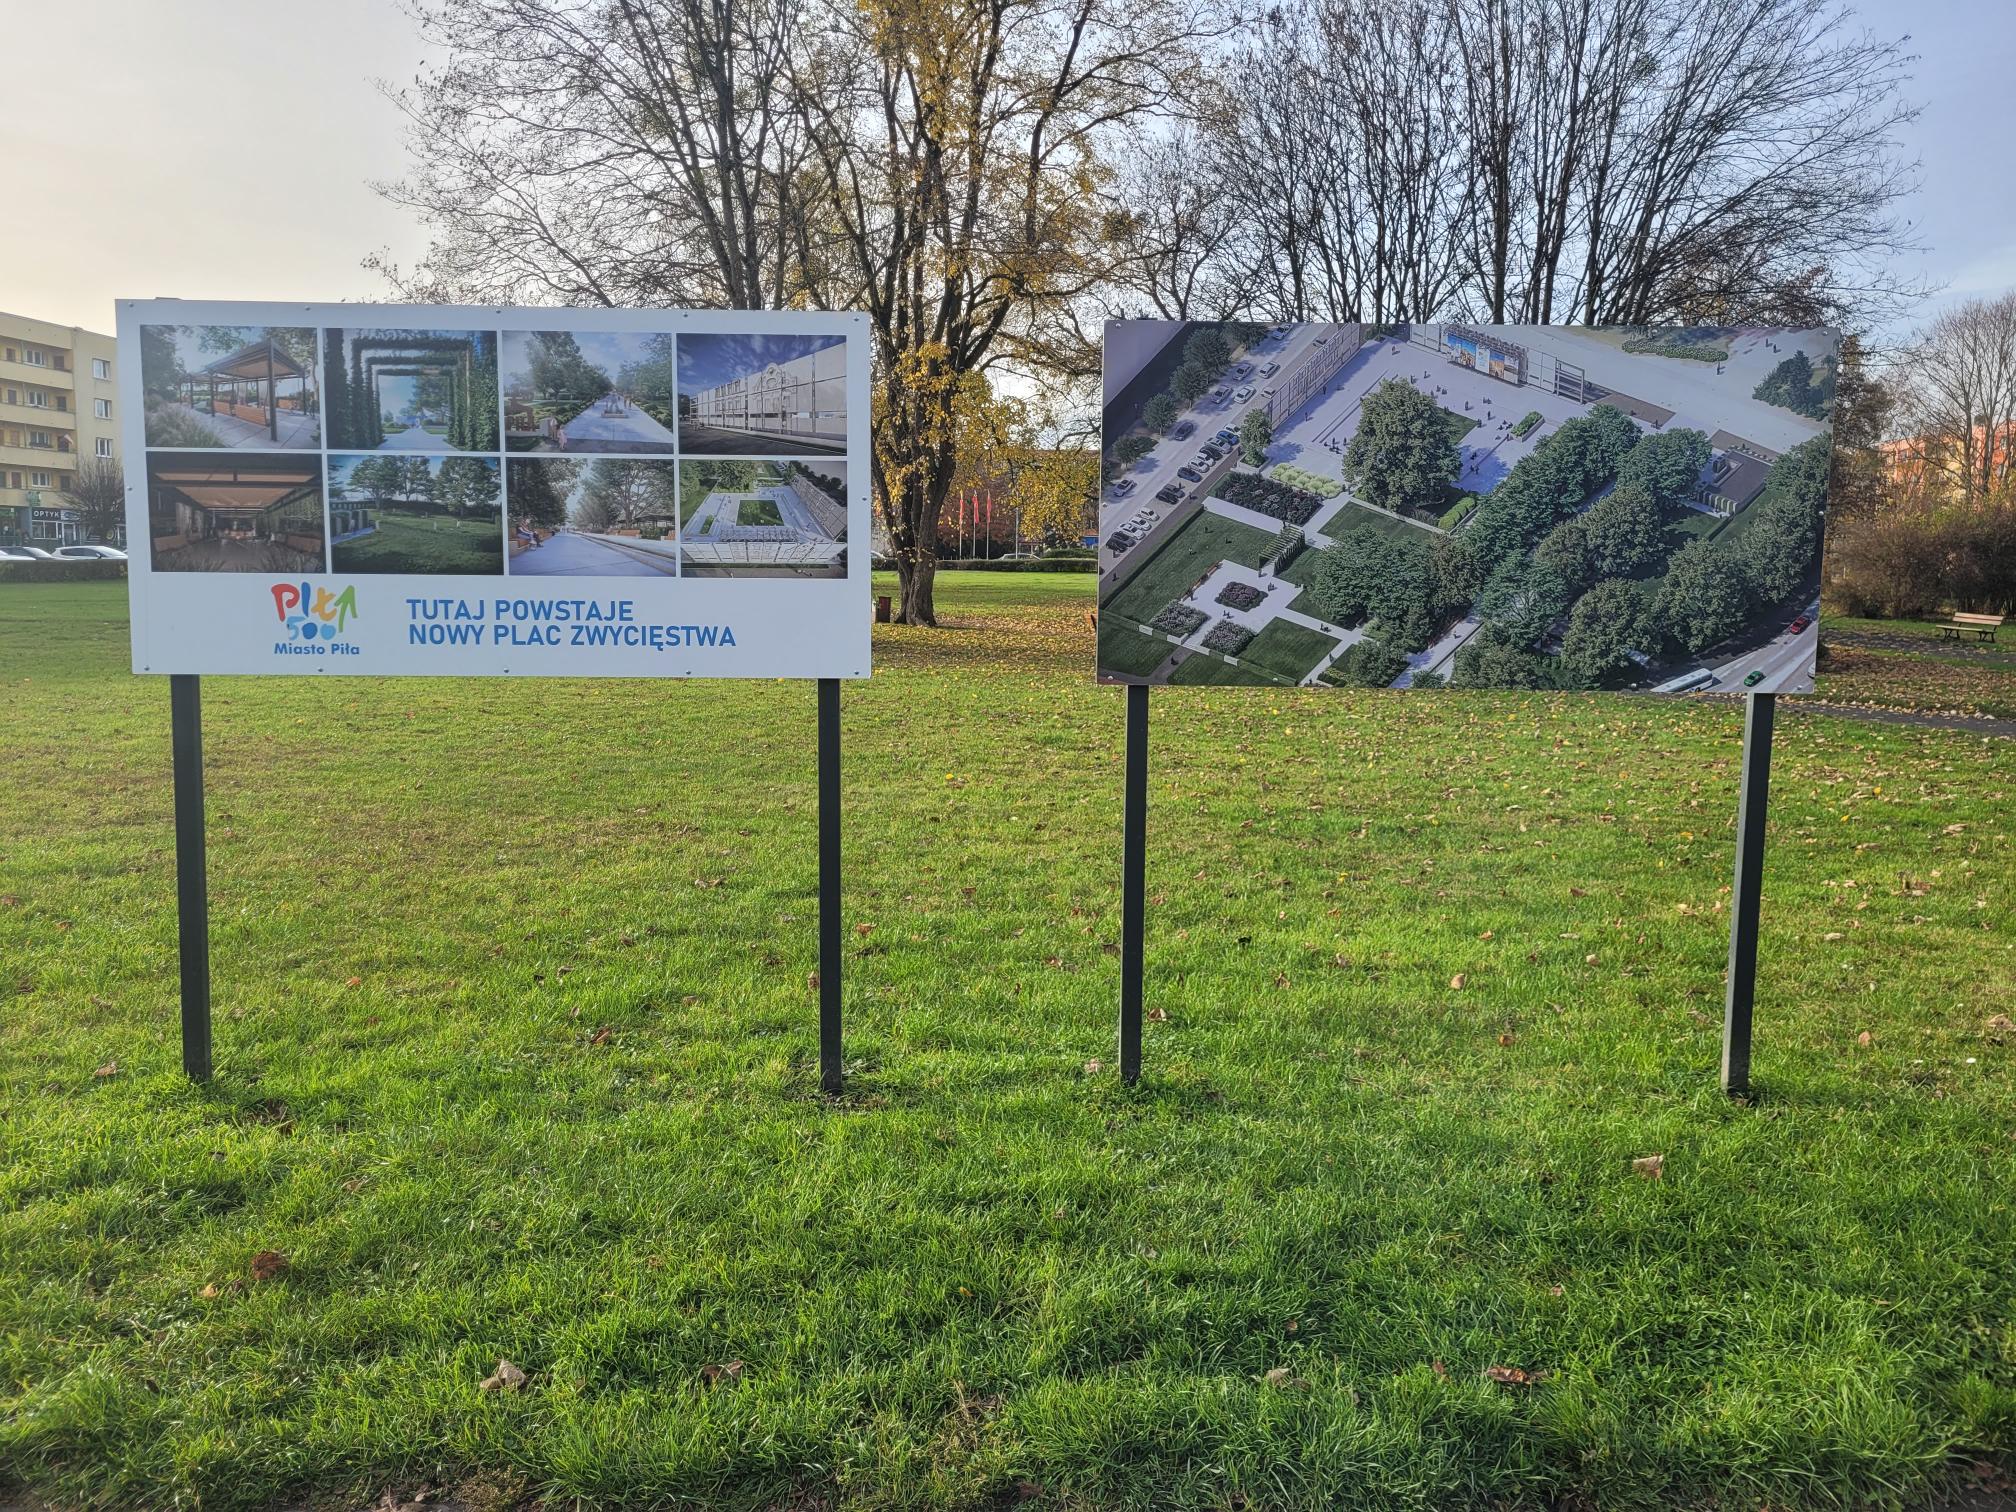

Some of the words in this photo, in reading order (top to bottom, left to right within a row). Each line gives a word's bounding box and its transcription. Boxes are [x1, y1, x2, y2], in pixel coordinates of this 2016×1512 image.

[33, 510, 60, 518] OPTYK
[406, 599, 486, 620] TUTAJ
[495, 600, 634, 621] POWSTAJE
[409, 624, 486, 645] NOWY
[494, 624, 562, 646] PLAC
[571, 625, 737, 652] ZWYCIĘSTWA
[274, 642, 325, 655] Miasto
[331, 642, 360, 655] Piła
